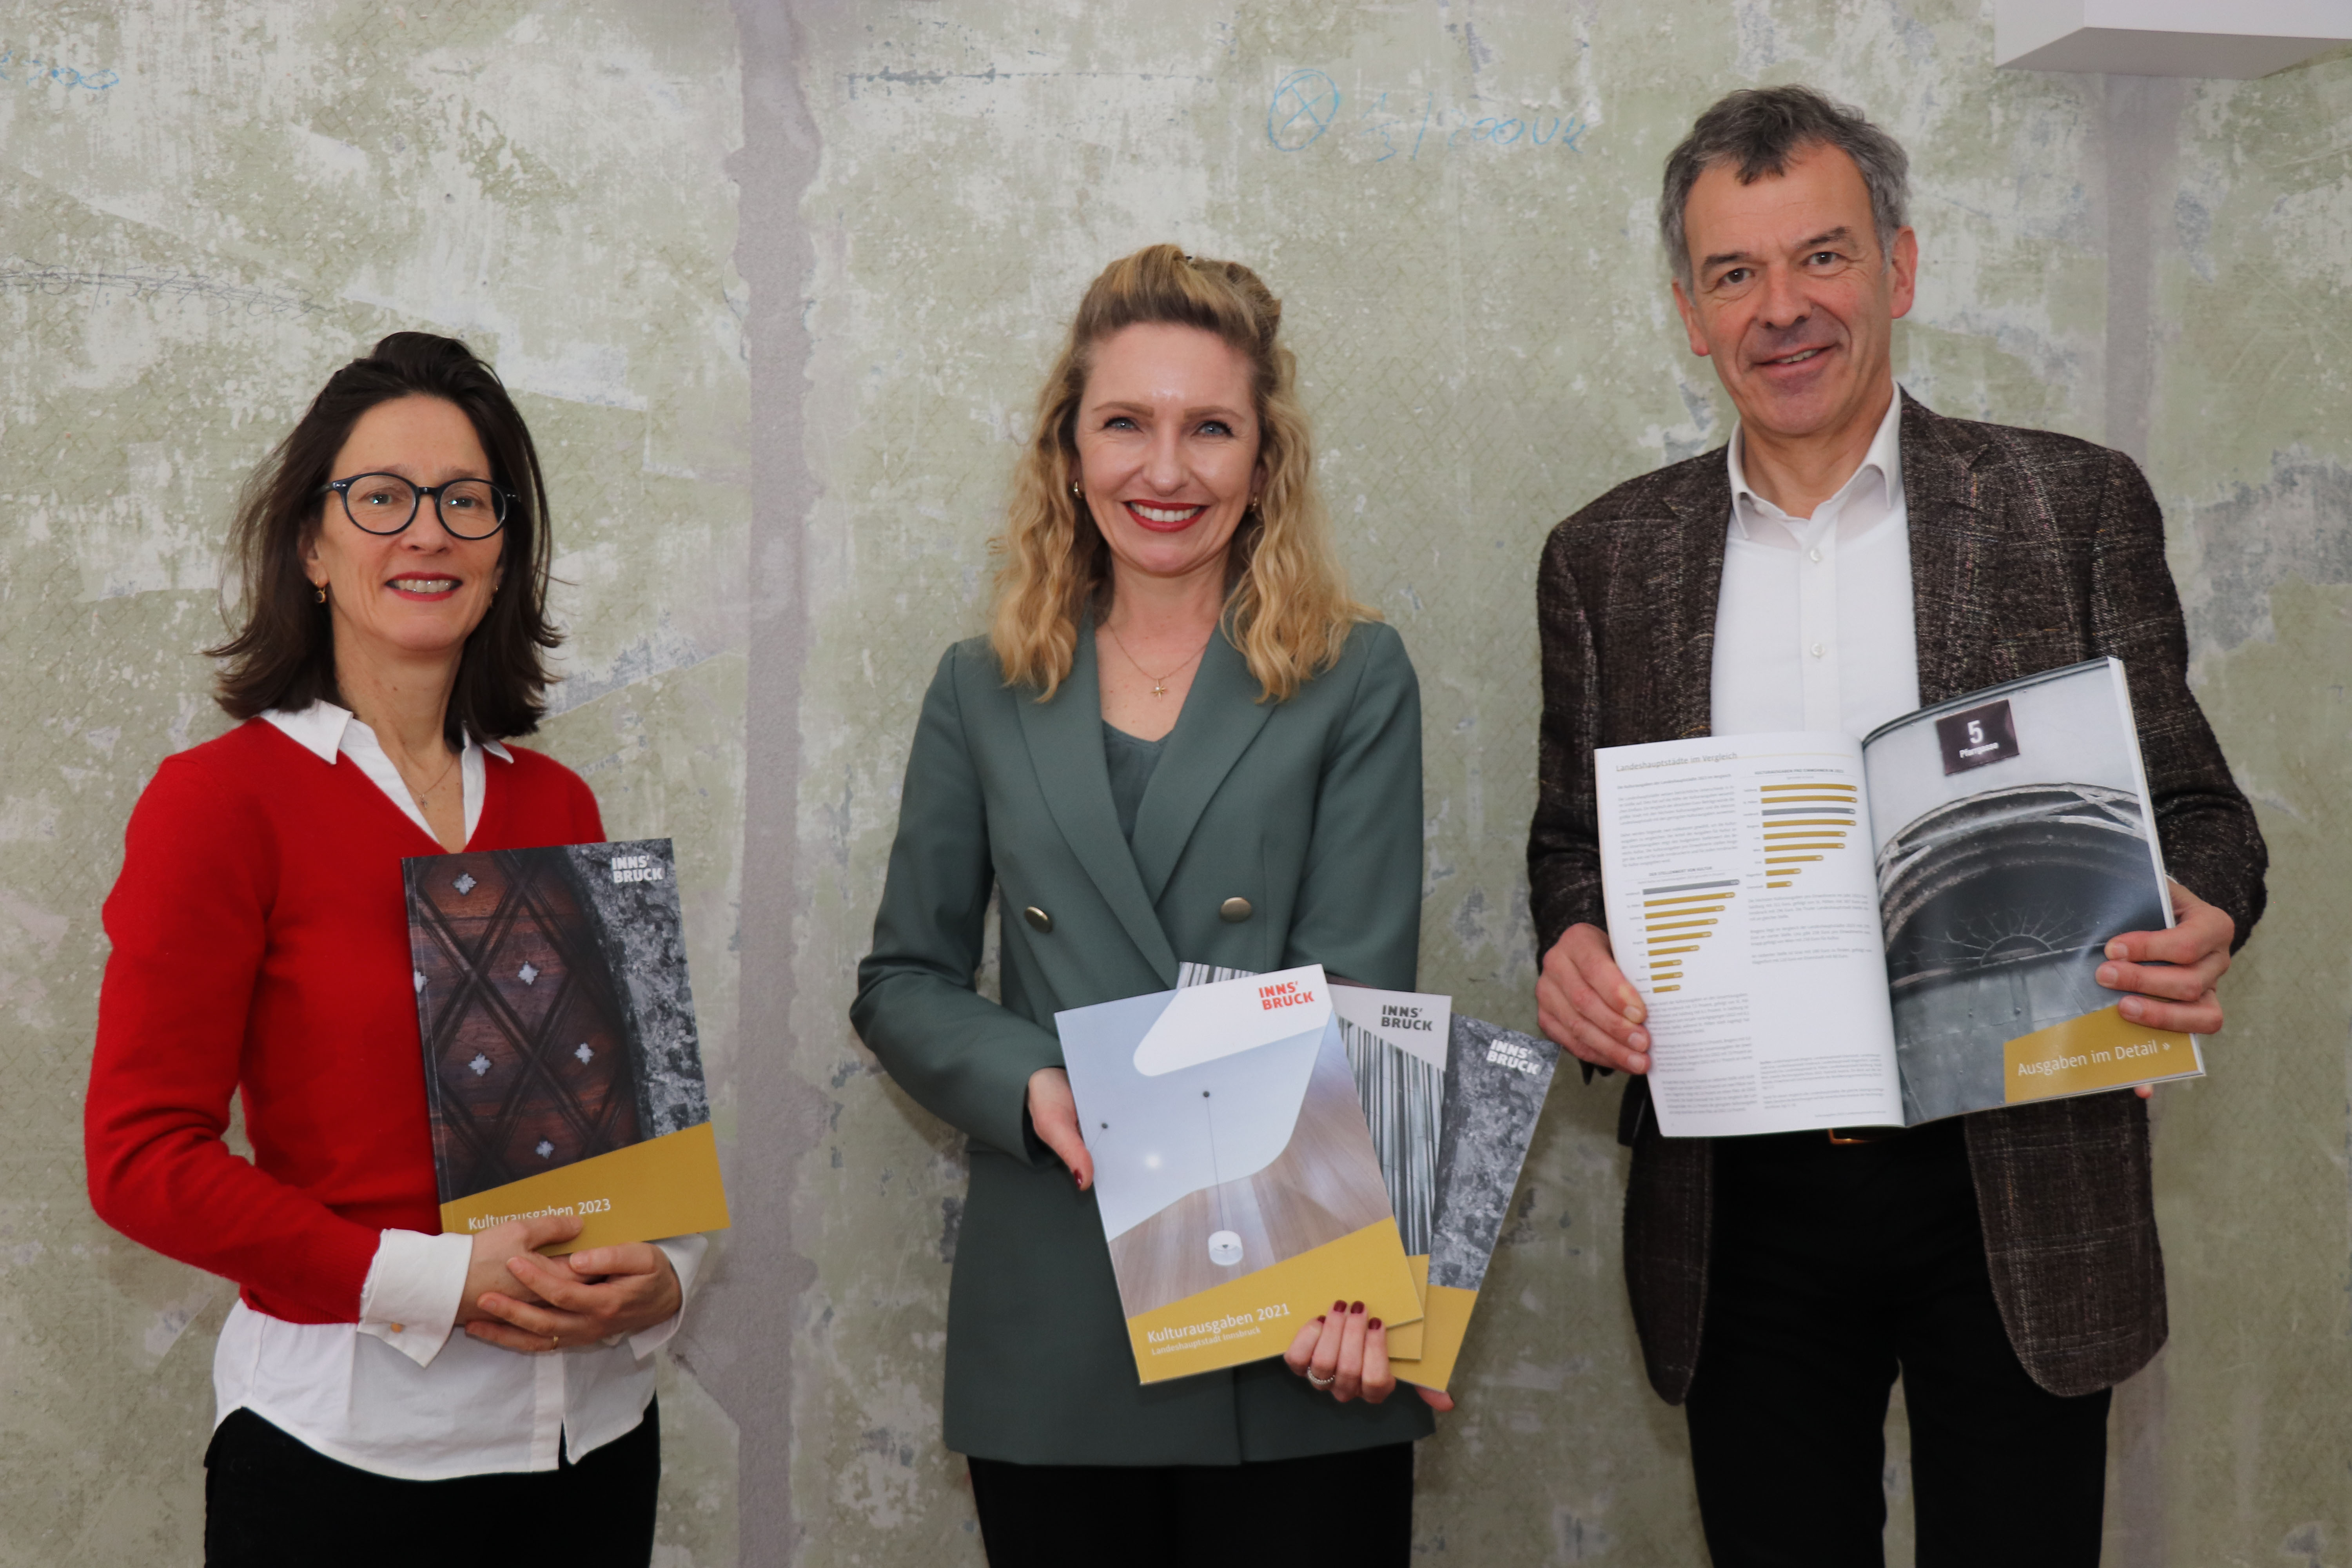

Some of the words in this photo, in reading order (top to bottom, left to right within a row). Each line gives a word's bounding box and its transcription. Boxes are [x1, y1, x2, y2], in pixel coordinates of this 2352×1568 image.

[1967, 720, 1984, 744] 5
[1616, 758, 1688, 771] Landeshauptstädte
[1702, 752, 1737, 762] Vergleich
[613, 867, 663, 883] BRUCK
[1262, 991, 1315, 1010] BRUCK
[1381, 1016, 1433, 1031] BRUCK
[1486, 1050, 1541, 1074] BRUCK
[2018, 1054, 2087, 1076] Ausgaben
[2091, 1050, 2111, 1064] im
[2115, 1039, 2158, 1060] Detail
[578, 1198, 611, 1214] 2023
[1147, 1312, 1253, 1343] Kulturausgaben
[1256, 1303, 1290, 1321] 2021
[1151, 1333, 1221, 1356] Landeshauptstadt
[1223, 1326, 1261, 1341] Innsbruck
